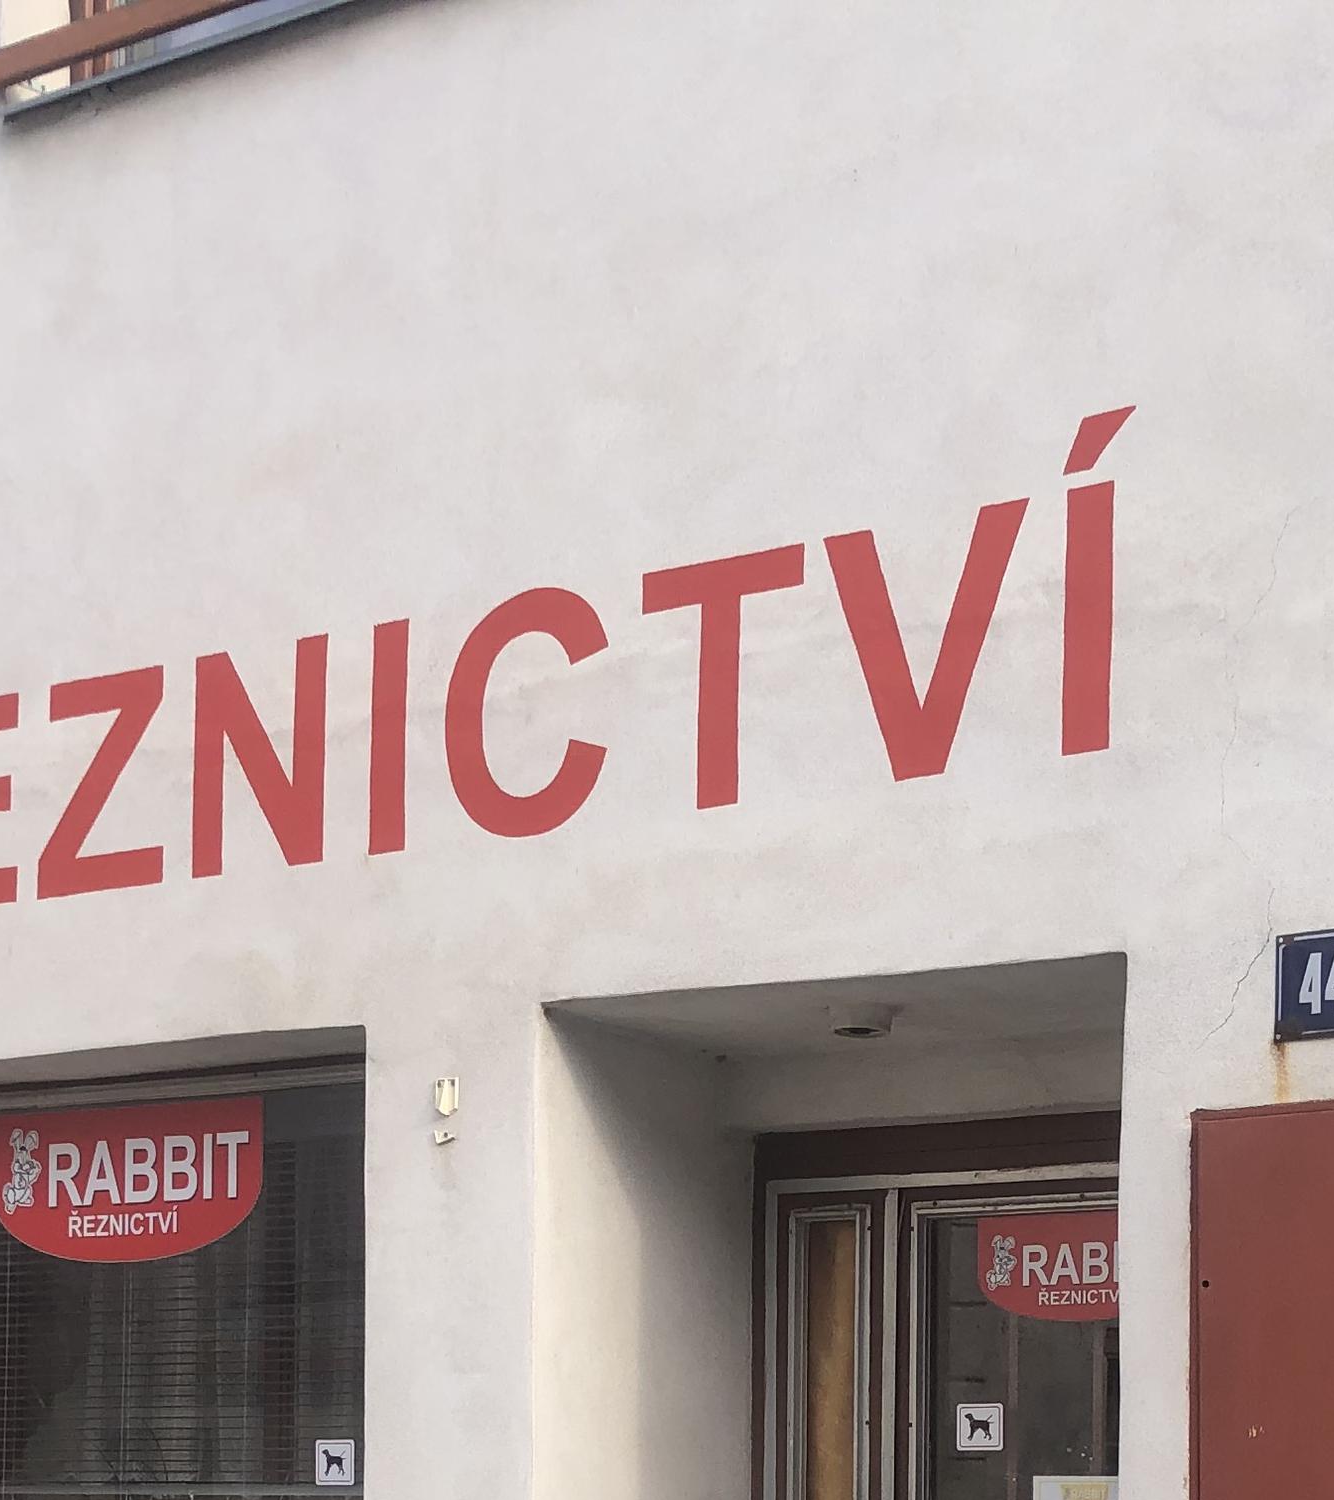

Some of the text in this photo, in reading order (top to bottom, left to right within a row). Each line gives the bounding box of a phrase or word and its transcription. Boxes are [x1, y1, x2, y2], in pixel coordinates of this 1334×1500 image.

[48, 1130, 250, 1208] RABBIT
[68, 1204, 179, 1238] ŘEZNICTVÍ
[1021, 1241, 1119, 1288] RAB
